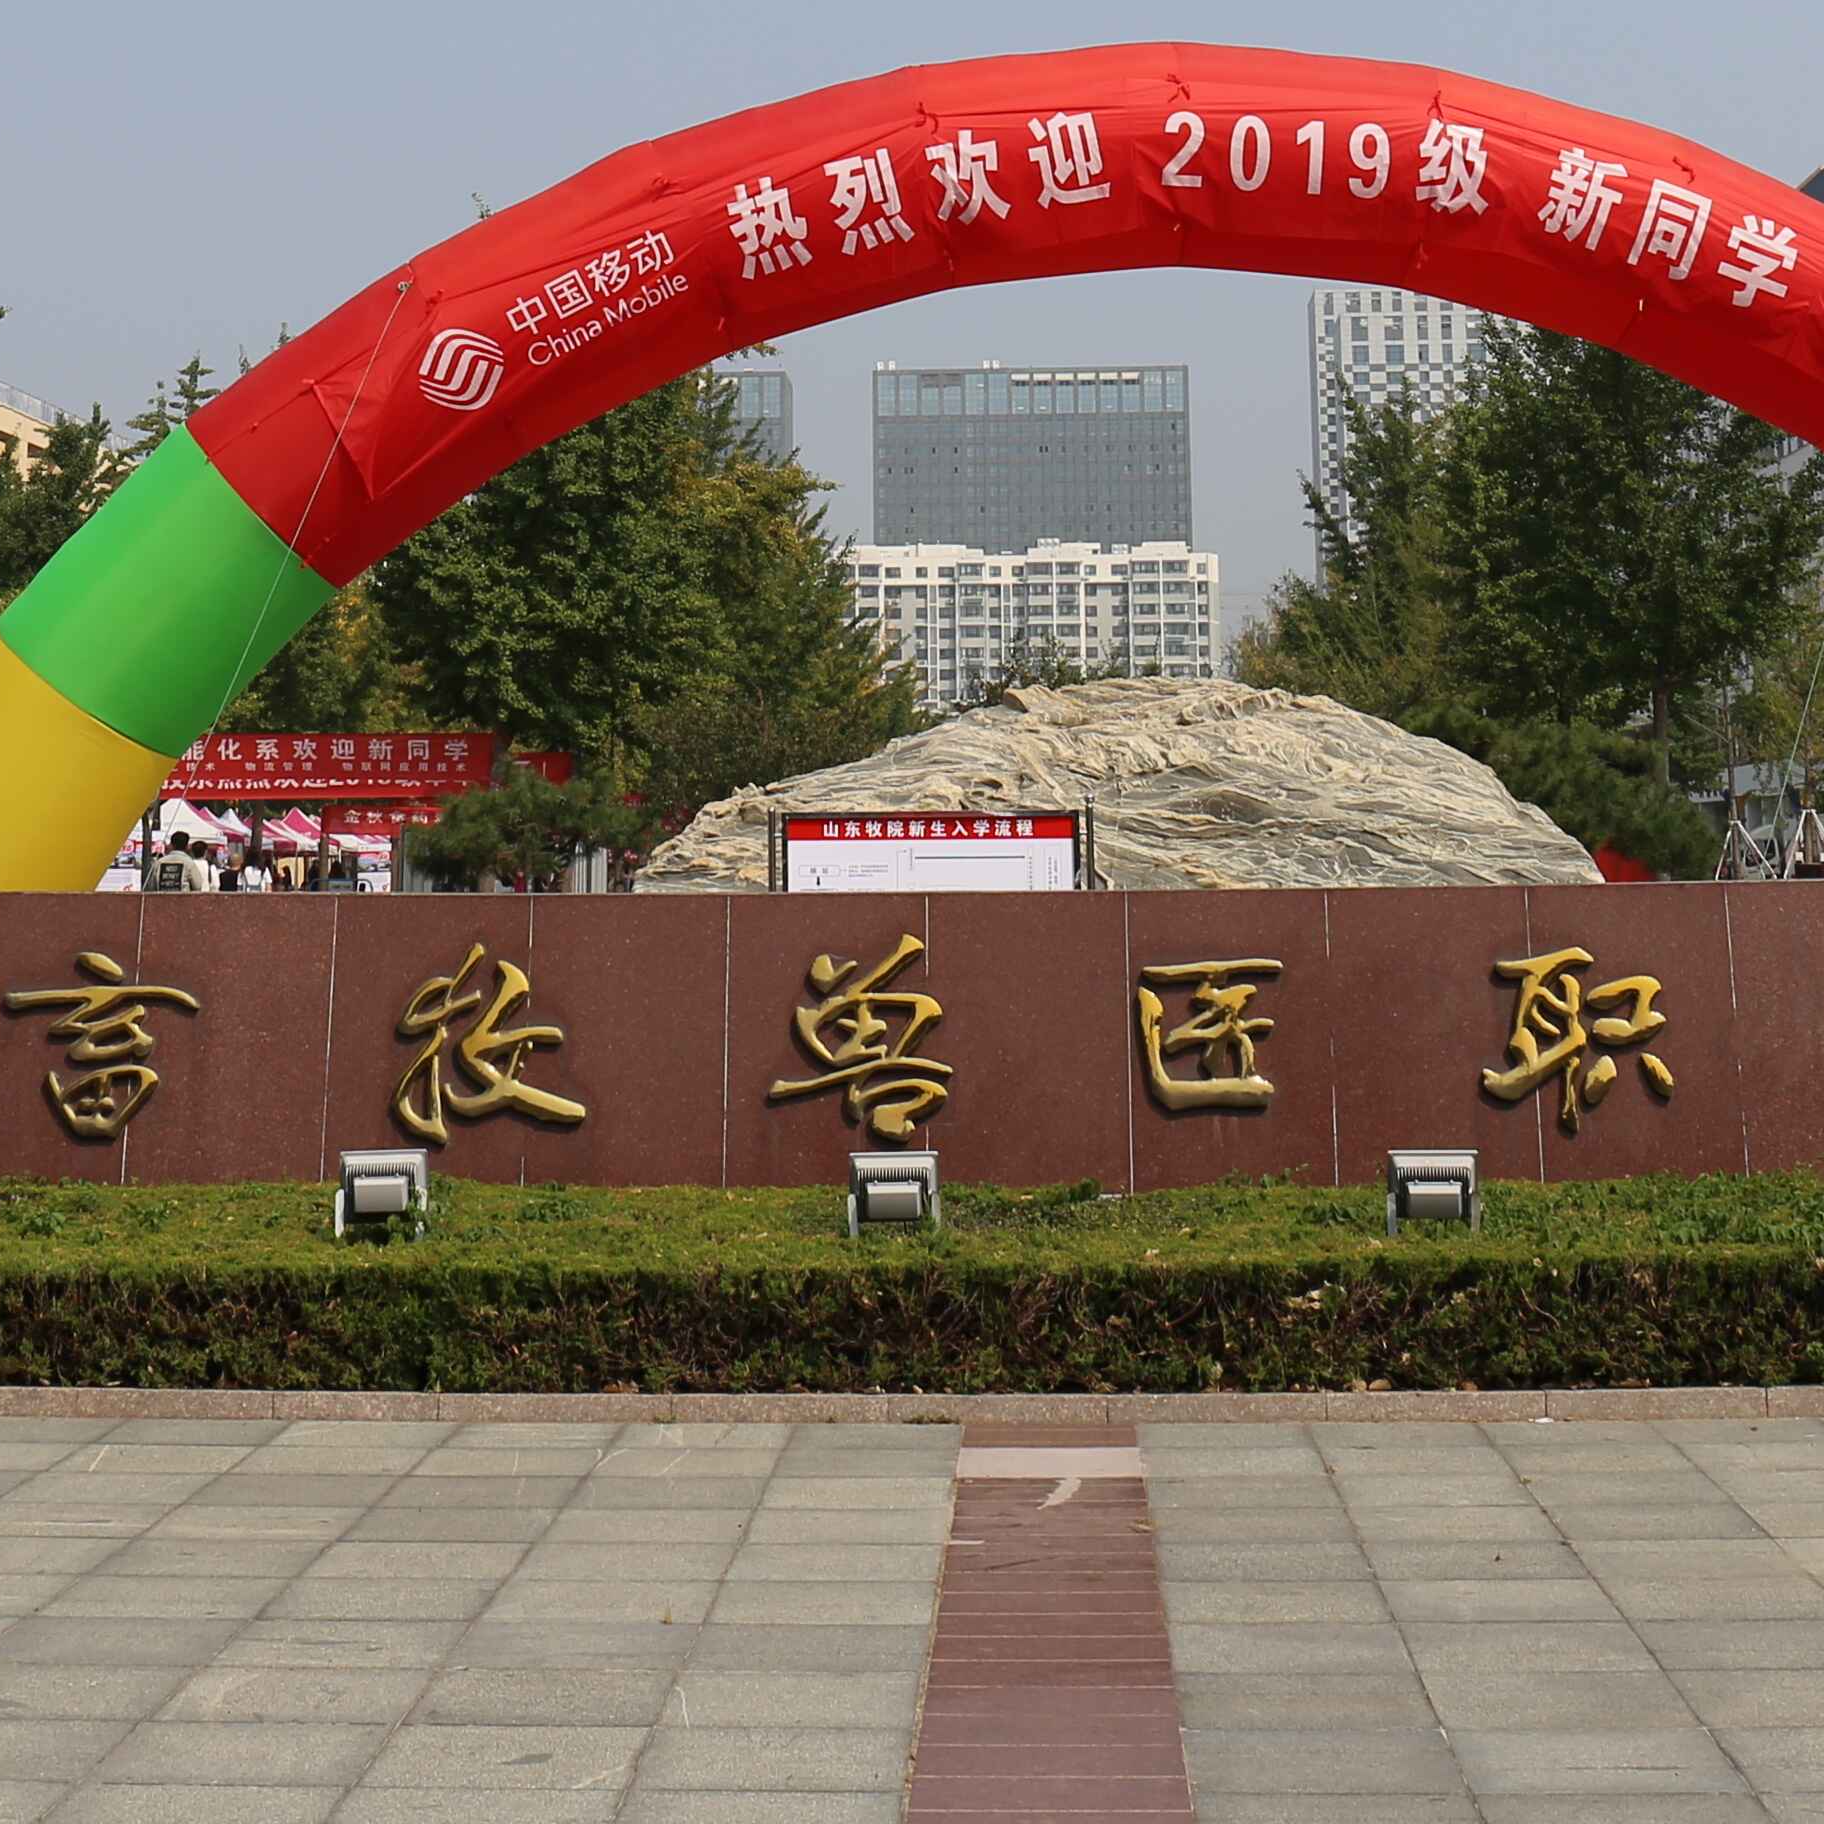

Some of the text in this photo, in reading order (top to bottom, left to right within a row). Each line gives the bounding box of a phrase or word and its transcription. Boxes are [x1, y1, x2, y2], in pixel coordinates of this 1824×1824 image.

[726, 110, 1800, 308] 热烈欢迎 2019级 新同学
[506, 230, 674, 335] 中国移动
[527, 274, 689, 366] China Mobile
[823, 819, 1035, 838] 山东牧院新生入学流程
